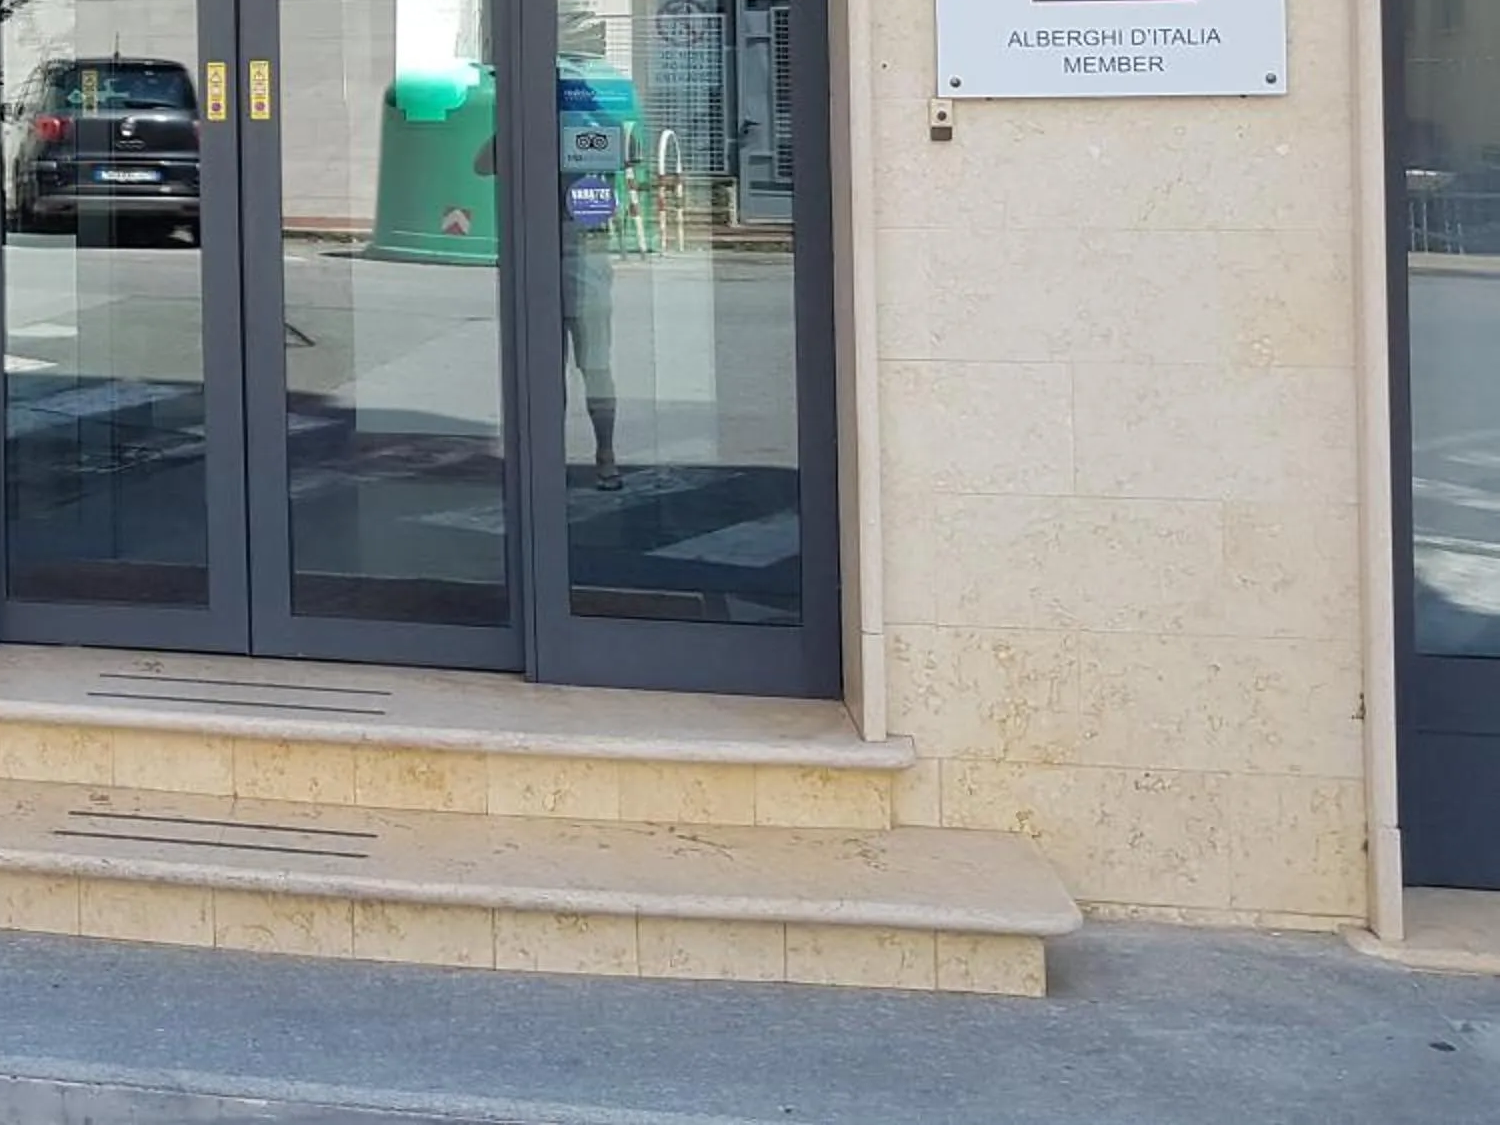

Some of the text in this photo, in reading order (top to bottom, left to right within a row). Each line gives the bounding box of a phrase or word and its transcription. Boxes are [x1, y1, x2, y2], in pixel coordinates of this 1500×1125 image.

[1007, 27, 1221, 48] ALBERGHI D'ITALIA
[1063, 56, 1165, 74] MEMBER
